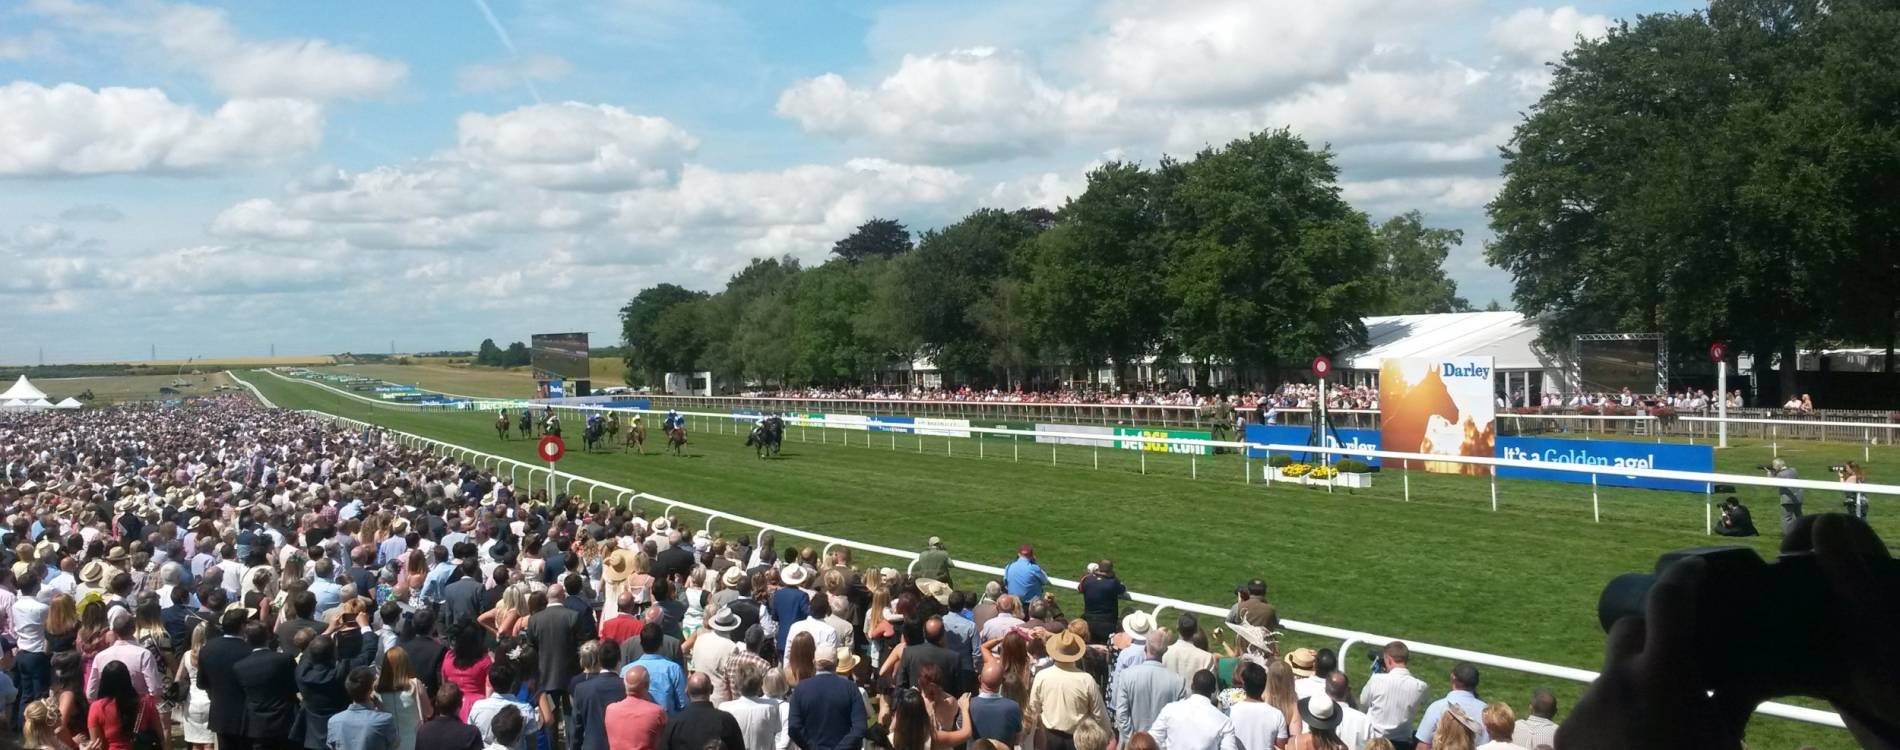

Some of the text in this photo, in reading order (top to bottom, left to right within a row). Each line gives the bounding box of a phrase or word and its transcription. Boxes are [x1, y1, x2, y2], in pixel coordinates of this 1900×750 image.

[1443, 362, 1489, 379] Darley
[1121, 428, 1205, 455] bet365.com
[1504, 447, 1654, 479] It's a Golden age!
